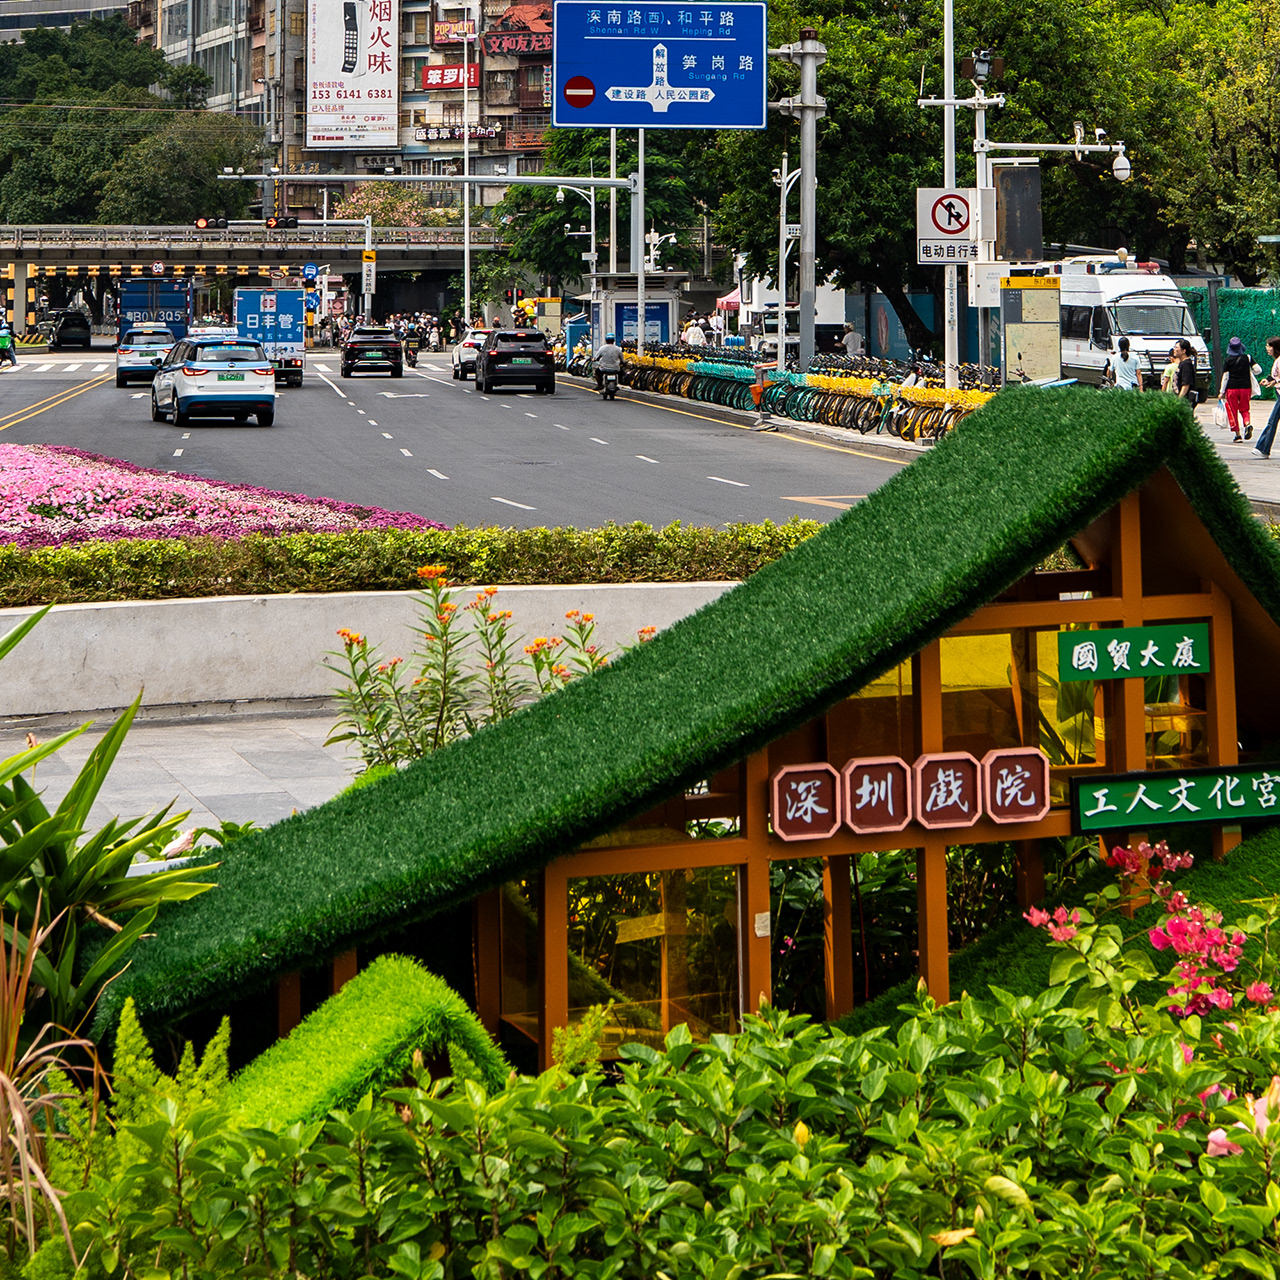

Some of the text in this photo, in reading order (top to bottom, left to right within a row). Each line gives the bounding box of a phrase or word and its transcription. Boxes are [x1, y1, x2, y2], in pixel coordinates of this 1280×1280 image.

[434, 22, 474, 35] POP MART
[589, 26, 731, 37] Shennan Rd W Heping Rd
[655, 48, 665, 87] 解放路
[682, 55, 754, 71] 笋岗路
[427, 68, 469, 84] 笨罗卜
[688, 72, 745, 82] Sungang Rd
[312, 90, 392, 99] 153 6141 6381
[611, 89, 647, 100] 建设路
[655, 89, 711, 101] 人民公园路
[922, 245, 978, 258] 电动自行车
[246, 314, 294, 329] 日丰管
